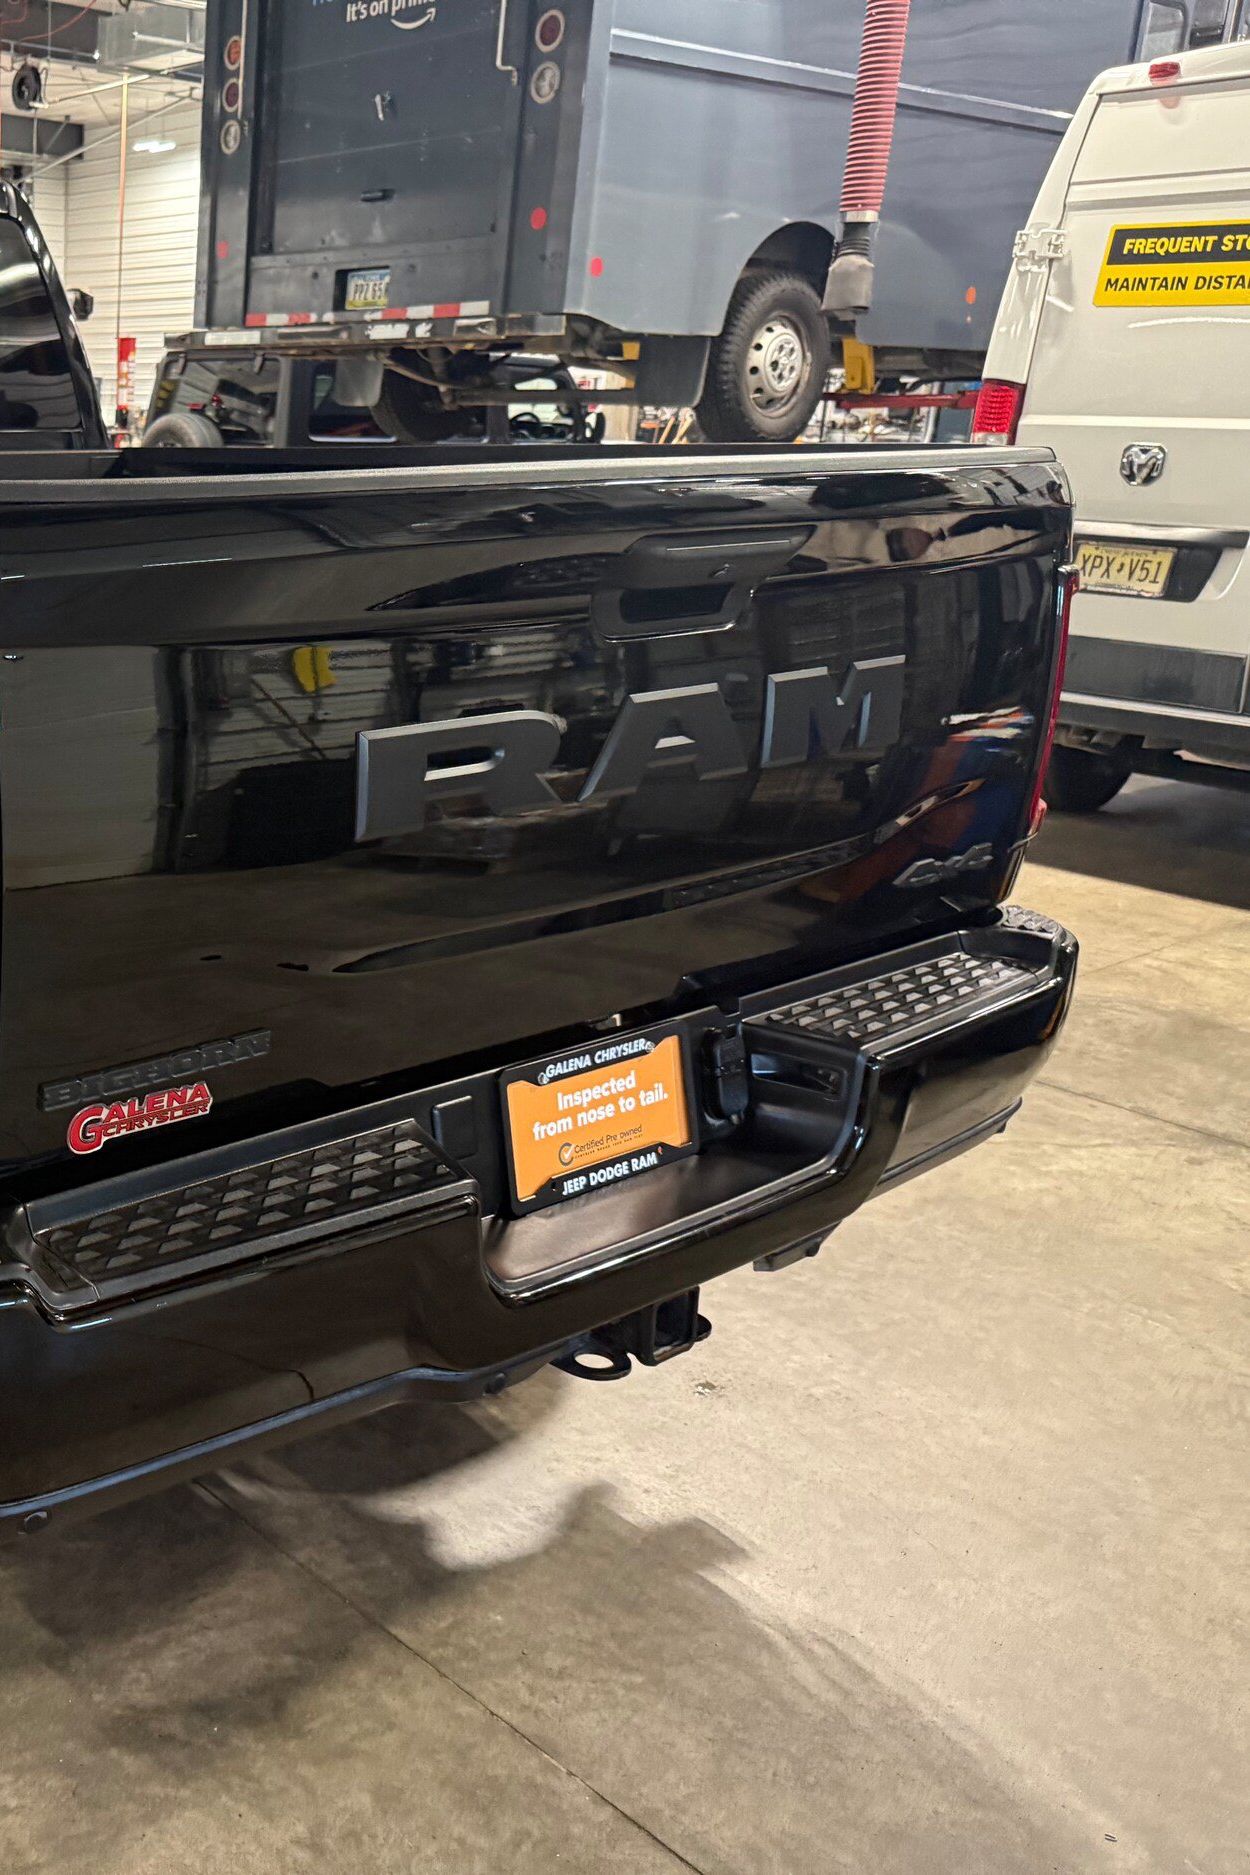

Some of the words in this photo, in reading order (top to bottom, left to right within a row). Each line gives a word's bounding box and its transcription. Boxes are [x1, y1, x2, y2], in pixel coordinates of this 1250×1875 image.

[1123, 235, 1218, 255] FREQUENT
[1221, 234, 1250, 251] ST
[1104, 276, 1188, 292] MAINTAIN
[1194, 275, 1250, 290] DISTA
[1080, 553, 1115, 579] XPX
[1127, 558, 1162, 584] V51
[356, 655, 906, 842] RAM
[545, 1054, 591, 1078] GALENA
[594, 1038, 646, 1064] CHRYSLER
[557, 1070, 636, 1111] Inspected
[70, 1083, 210, 1152] GALENA
[102, 1103, 209, 1137] CHRYSLER
[532, 1117, 572, 1141] from
[577, 1103, 615, 1127] nose
[618, 1096, 636, 1113] to
[639, 1083, 668, 1106] tail.
[574, 1136, 604, 1154] Certified
[606, 1134, 618, 1143] Pre
[619, 1124, 642, 1139] owned
[562, 1175, 586, 1195] JEEP
[589, 1164, 629, 1186] DODGE
[631, 1151, 658, 1171] RAM
